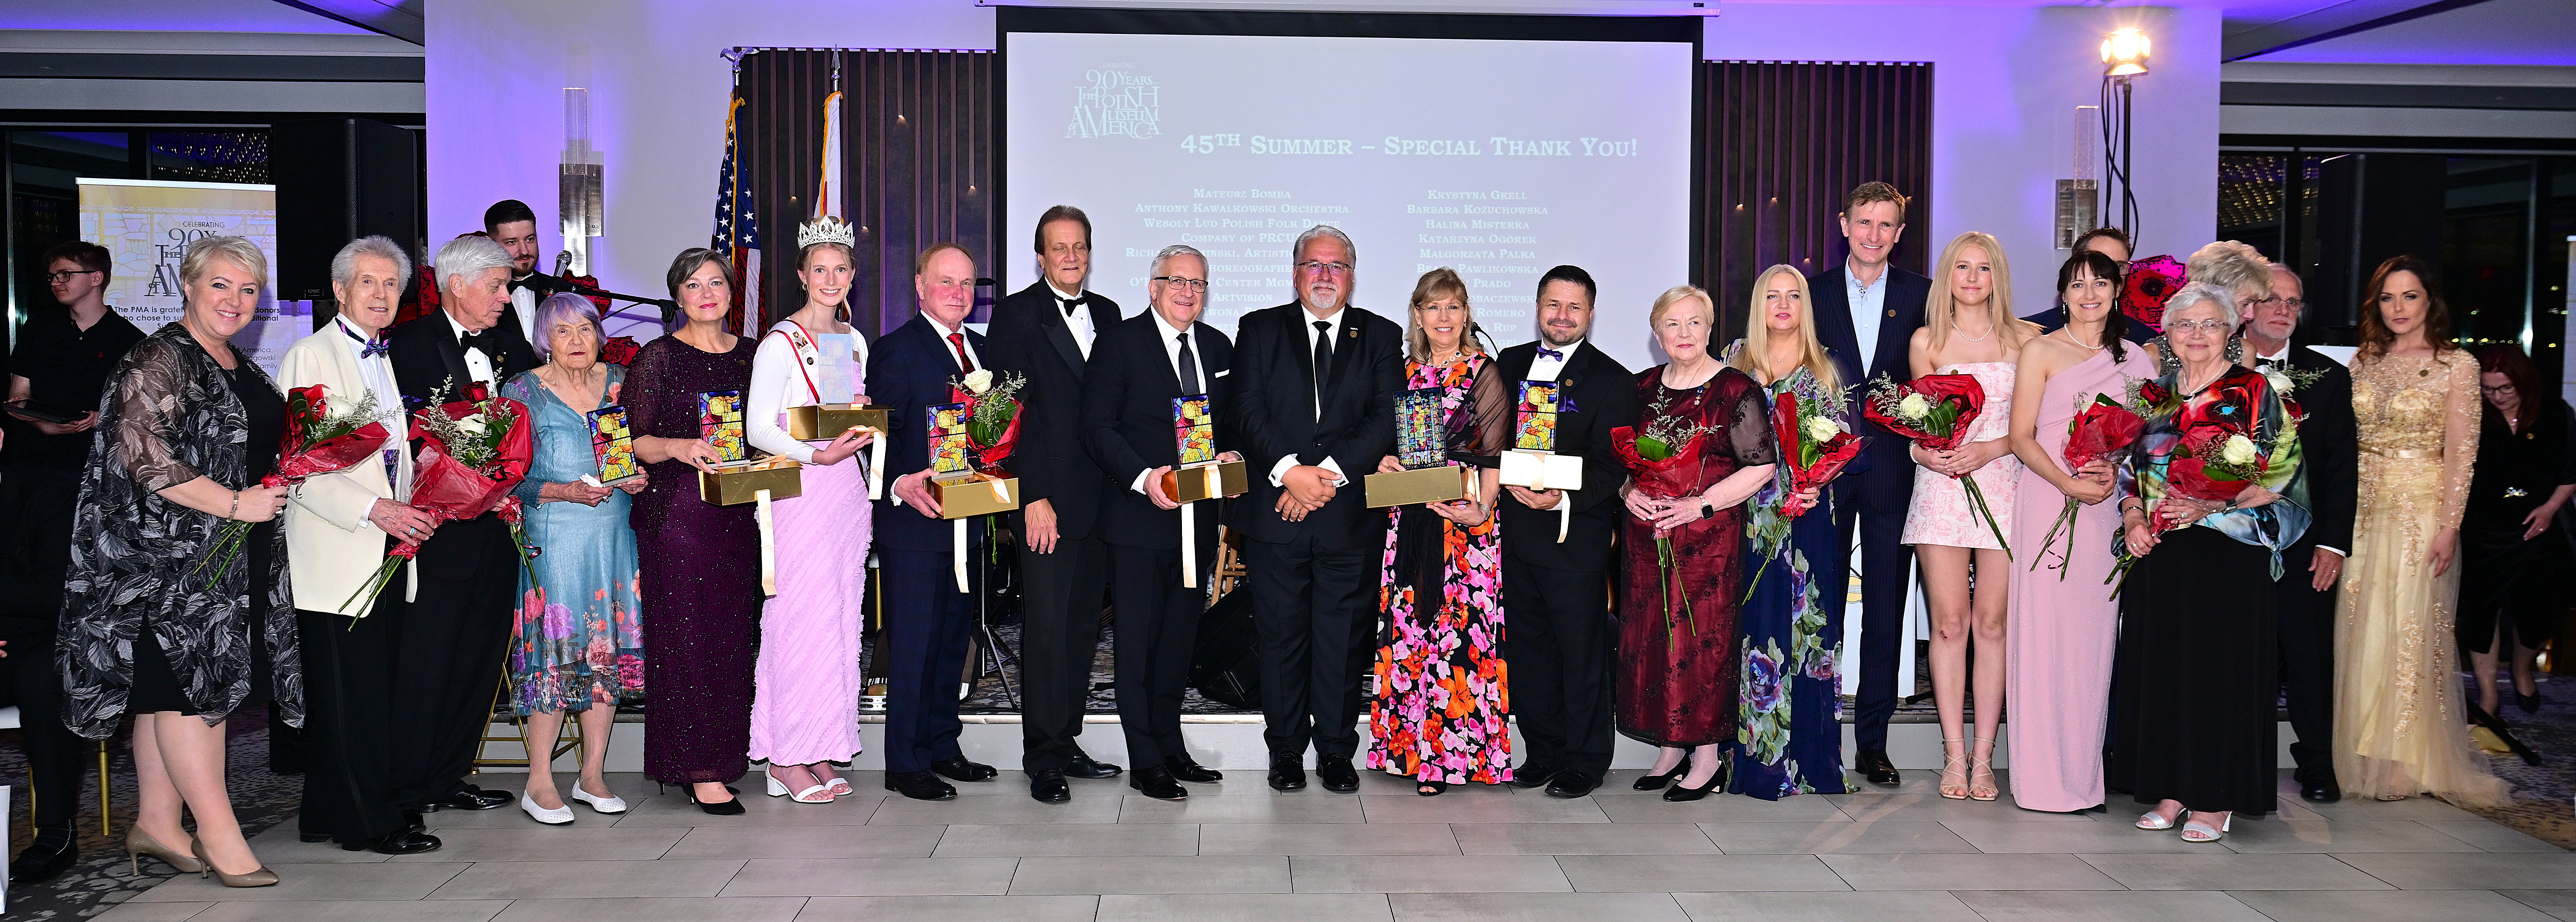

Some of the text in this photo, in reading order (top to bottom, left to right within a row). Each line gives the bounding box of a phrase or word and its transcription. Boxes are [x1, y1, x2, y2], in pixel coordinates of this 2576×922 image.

[1086, 70, 1153, 92] 90 YEARS
[1094, 86, 1160, 110] POLISH
[1181, 133, 1241, 154] 45TH
[1251, 135, 1353, 154] SUMMER
[1384, 136, 1481, 155] SPECIAL
[1490, 137, 1571, 155] THANK
[1580, 137, 1637, 157] YOU!
[1194, 189, 1291, 198] MATEUSZ BOMBA
[1428, 190, 1527, 199] KRYSTYNA GRELL
[1135, 203, 1349, 213] ANTHONY KAWALKOWSKI ORCHESTRA
[1407, 205, 1459, 213] BARBARA
[1195, 218, 1218, 227] LUD
[1222, 219, 1262, 228] POLISH
[1268, 219, 1298, 228] FOLK
[1426, 219, 1529, 229] HALINA MISTERKA
[1182, 233, 1235, 242] COMPANY
[1418, 234, 1536, 243] KATARZYNA OGÓREK
[1126, 248, 1161, 257] RICHA
[1499, 249, 1535, 258] PALKA
[1458, 264, 1538, 273] PAWLIKOWSKA
[1216, 278, 1261, 287] CENTER
[1473, 278, 1511, 288] PRADO
[1212, 293, 1272, 302] ARTVISION
[1203, 307, 1240, 316] IWONA
[1476, 308, 1525, 317] ROMERO
[1494, 323, 1516, 332] RUP
[800, 345, 812, 355] 2025
